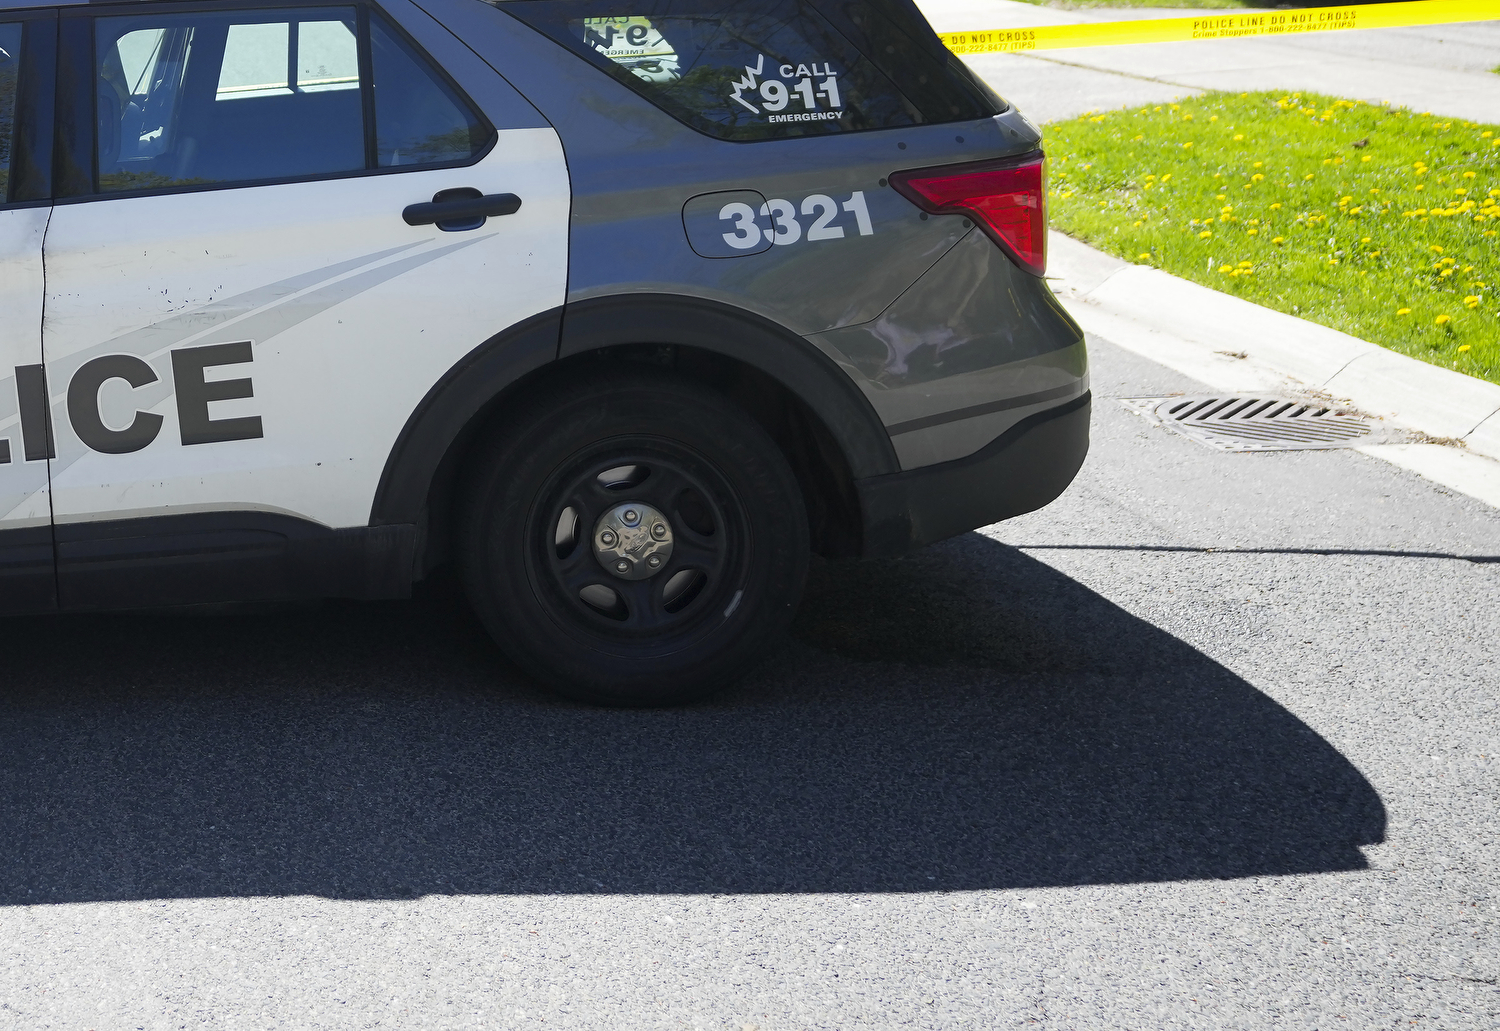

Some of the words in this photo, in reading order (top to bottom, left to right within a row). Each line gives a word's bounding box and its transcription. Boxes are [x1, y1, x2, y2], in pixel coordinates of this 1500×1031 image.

[1193, 18, 1234, 30] POLICE
[1240, 16, 1266, 27] LINE
[1271, 14, 1286, 25] DO
[1291, 12, 1314, 23] NOT
[1319, 10, 1357, 21] CROSS
[951, 35, 966, 45] DO
[972, 33, 993, 43] NOT
[999, 31, 1036, 42] CROSS
[1192, 29, 1217, 39] Crime
[1220, 28, 1257, 37] Stoppers
[1261, 24, 1327, 33] 1-800-222-8477
[1329, 20, 1356, 30] (TIPS)
[951, 43, 1008, 54] 800-222-8477
[1011, 41, 1036, 51] (TIPS)
[779, 62, 837, 78] CALL
[759, 76, 842, 112] 9-1-1
[768, 111, 843, 123] EMERGENCY
[719, 190, 874, 249] 3321
